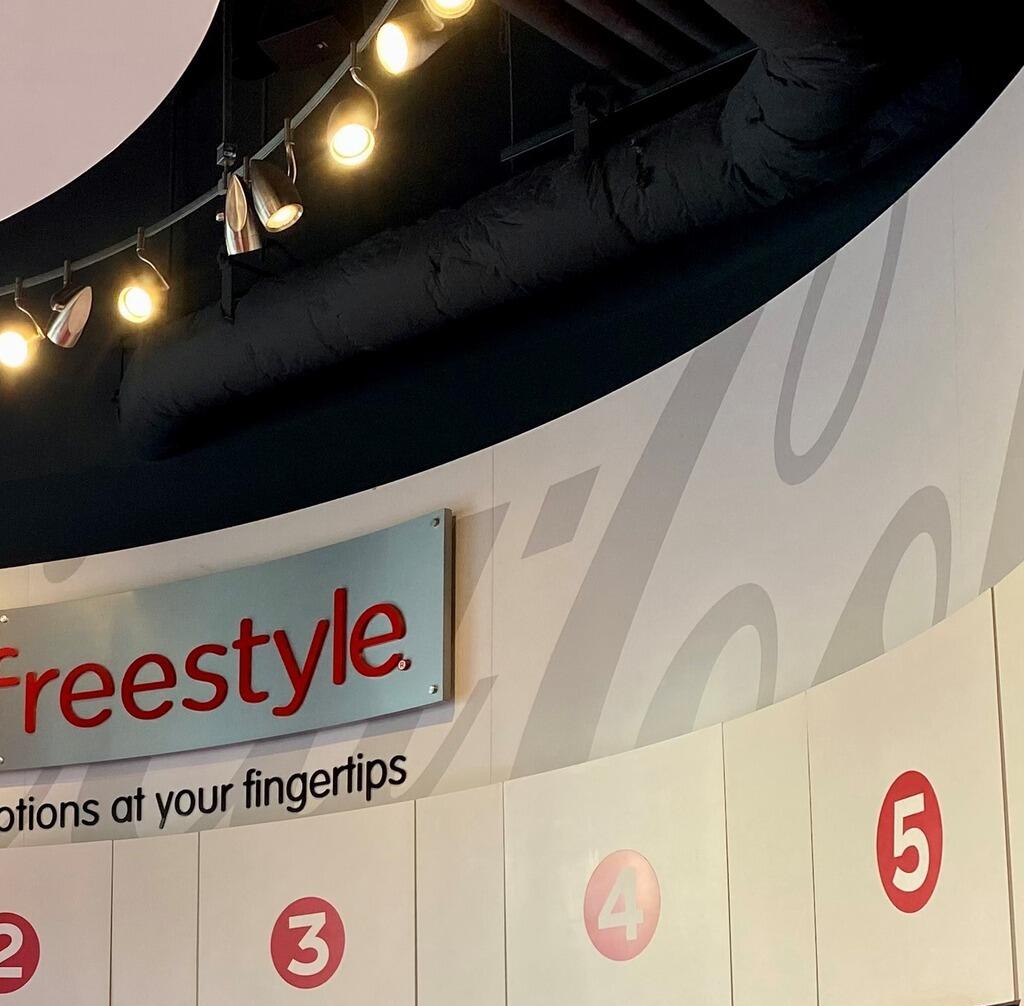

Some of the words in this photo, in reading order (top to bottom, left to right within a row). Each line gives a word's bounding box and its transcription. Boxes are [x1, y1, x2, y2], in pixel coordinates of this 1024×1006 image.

[111, 786, 145, 823] at
[155, 782, 235, 830] your
[242, 752, 408, 814] fingertips
[892, 792, 930, 893] 5
[598, 866, 644, 942] 4
[287, 911, 329, 976] 3
